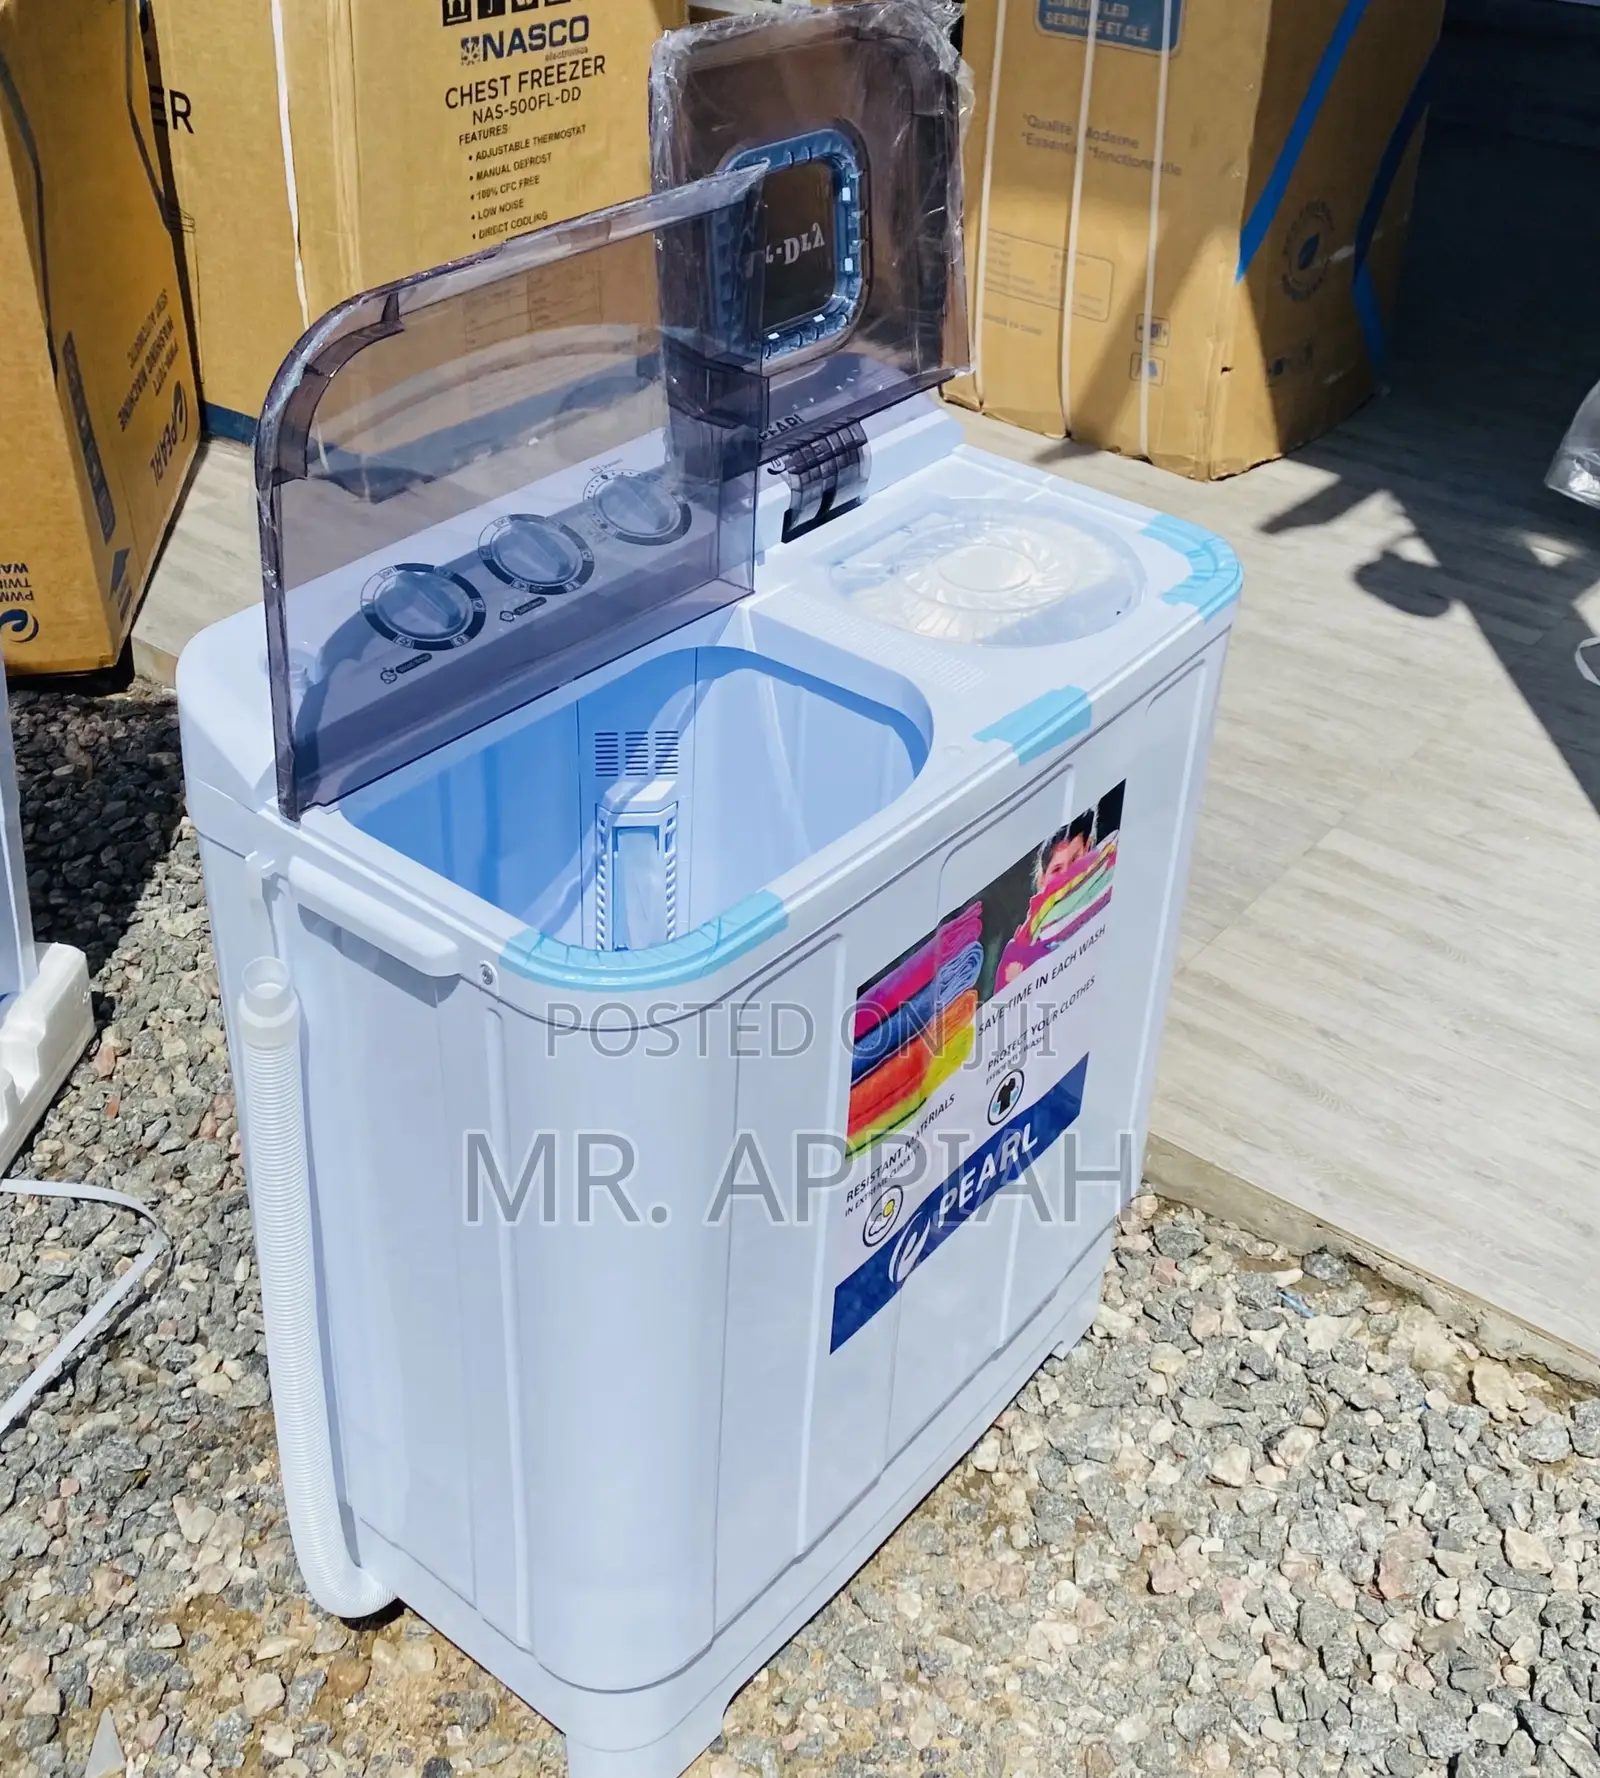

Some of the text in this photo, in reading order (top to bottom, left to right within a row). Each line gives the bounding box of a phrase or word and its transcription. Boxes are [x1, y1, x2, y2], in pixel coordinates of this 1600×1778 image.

[482, 15, 589, 61] NASCO
[1105, 22, 1123, 36] ET
[445, 55, 605, 109] CHEST FREEZER
[473, 86, 581, 125] NAS-500FL-DD
[476, 124, 586, 161] ADJUSTABLE THERMOSTAT
[476, 152, 552, 181] MANUAL DEFROST
[476, 175, 540, 201] 100% CFC FREE
[478, 198, 524, 220] LOW NOISE
[479, 211, 548, 240] DIRECT COOLING
[150, 412, 179, 487] PEARL
[0, 562, 29, 574] WA
[0, 578, 32, 589] TWI
[978, 924, 1106, 1036] SAVE TIME IN EACH WASH
[988, 976, 1096, 1072] PROTECT YOUR CLOTHES
[1024, 1035, 1045, 1052] WASH
[846, 1094, 955, 1203] RESISTANT MATERIALS
[937, 1123, 1038, 1229] PEARL
[845, 1204, 854, 1217] IN
